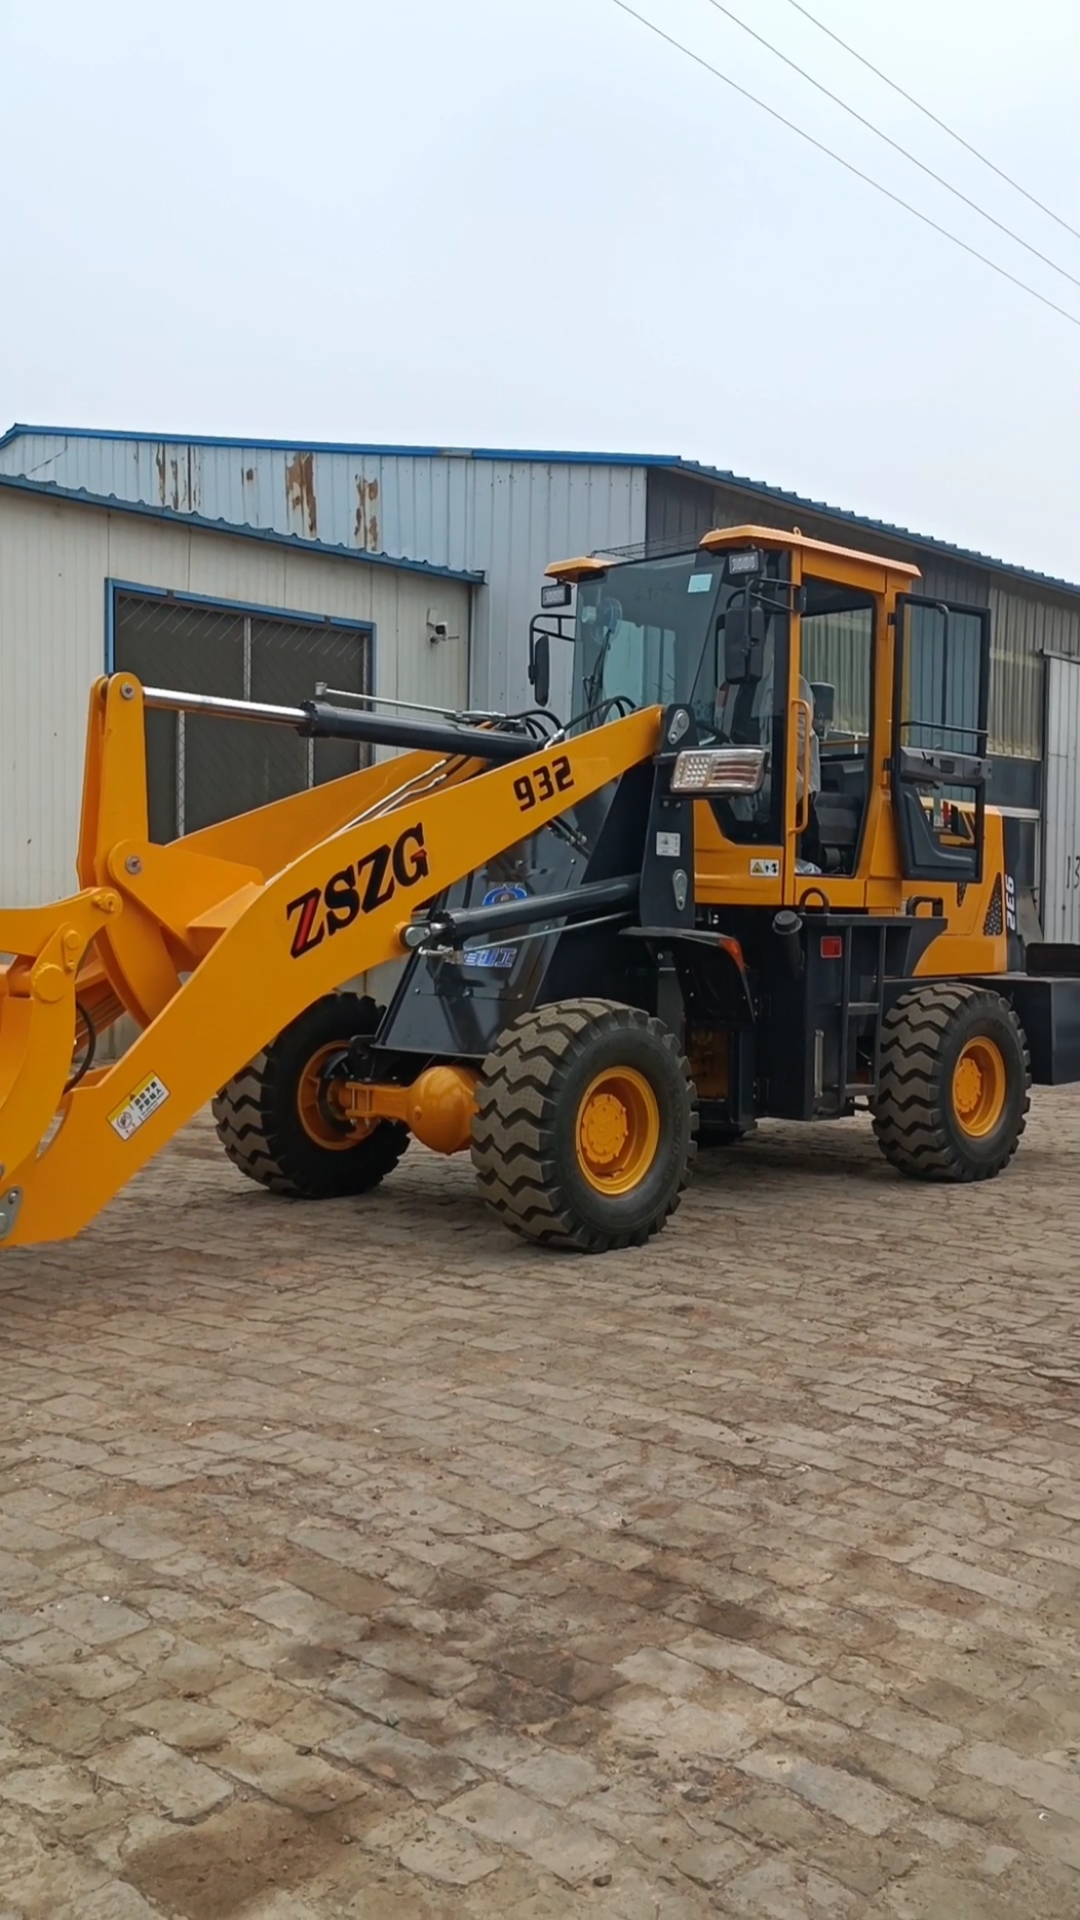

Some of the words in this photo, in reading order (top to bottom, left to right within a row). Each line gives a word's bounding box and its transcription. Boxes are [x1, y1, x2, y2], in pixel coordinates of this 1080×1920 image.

[512, 755, 575, 812] 932
[286, 822, 429, 960] ZSZG
[1005, 874, 1016, 931] 932
